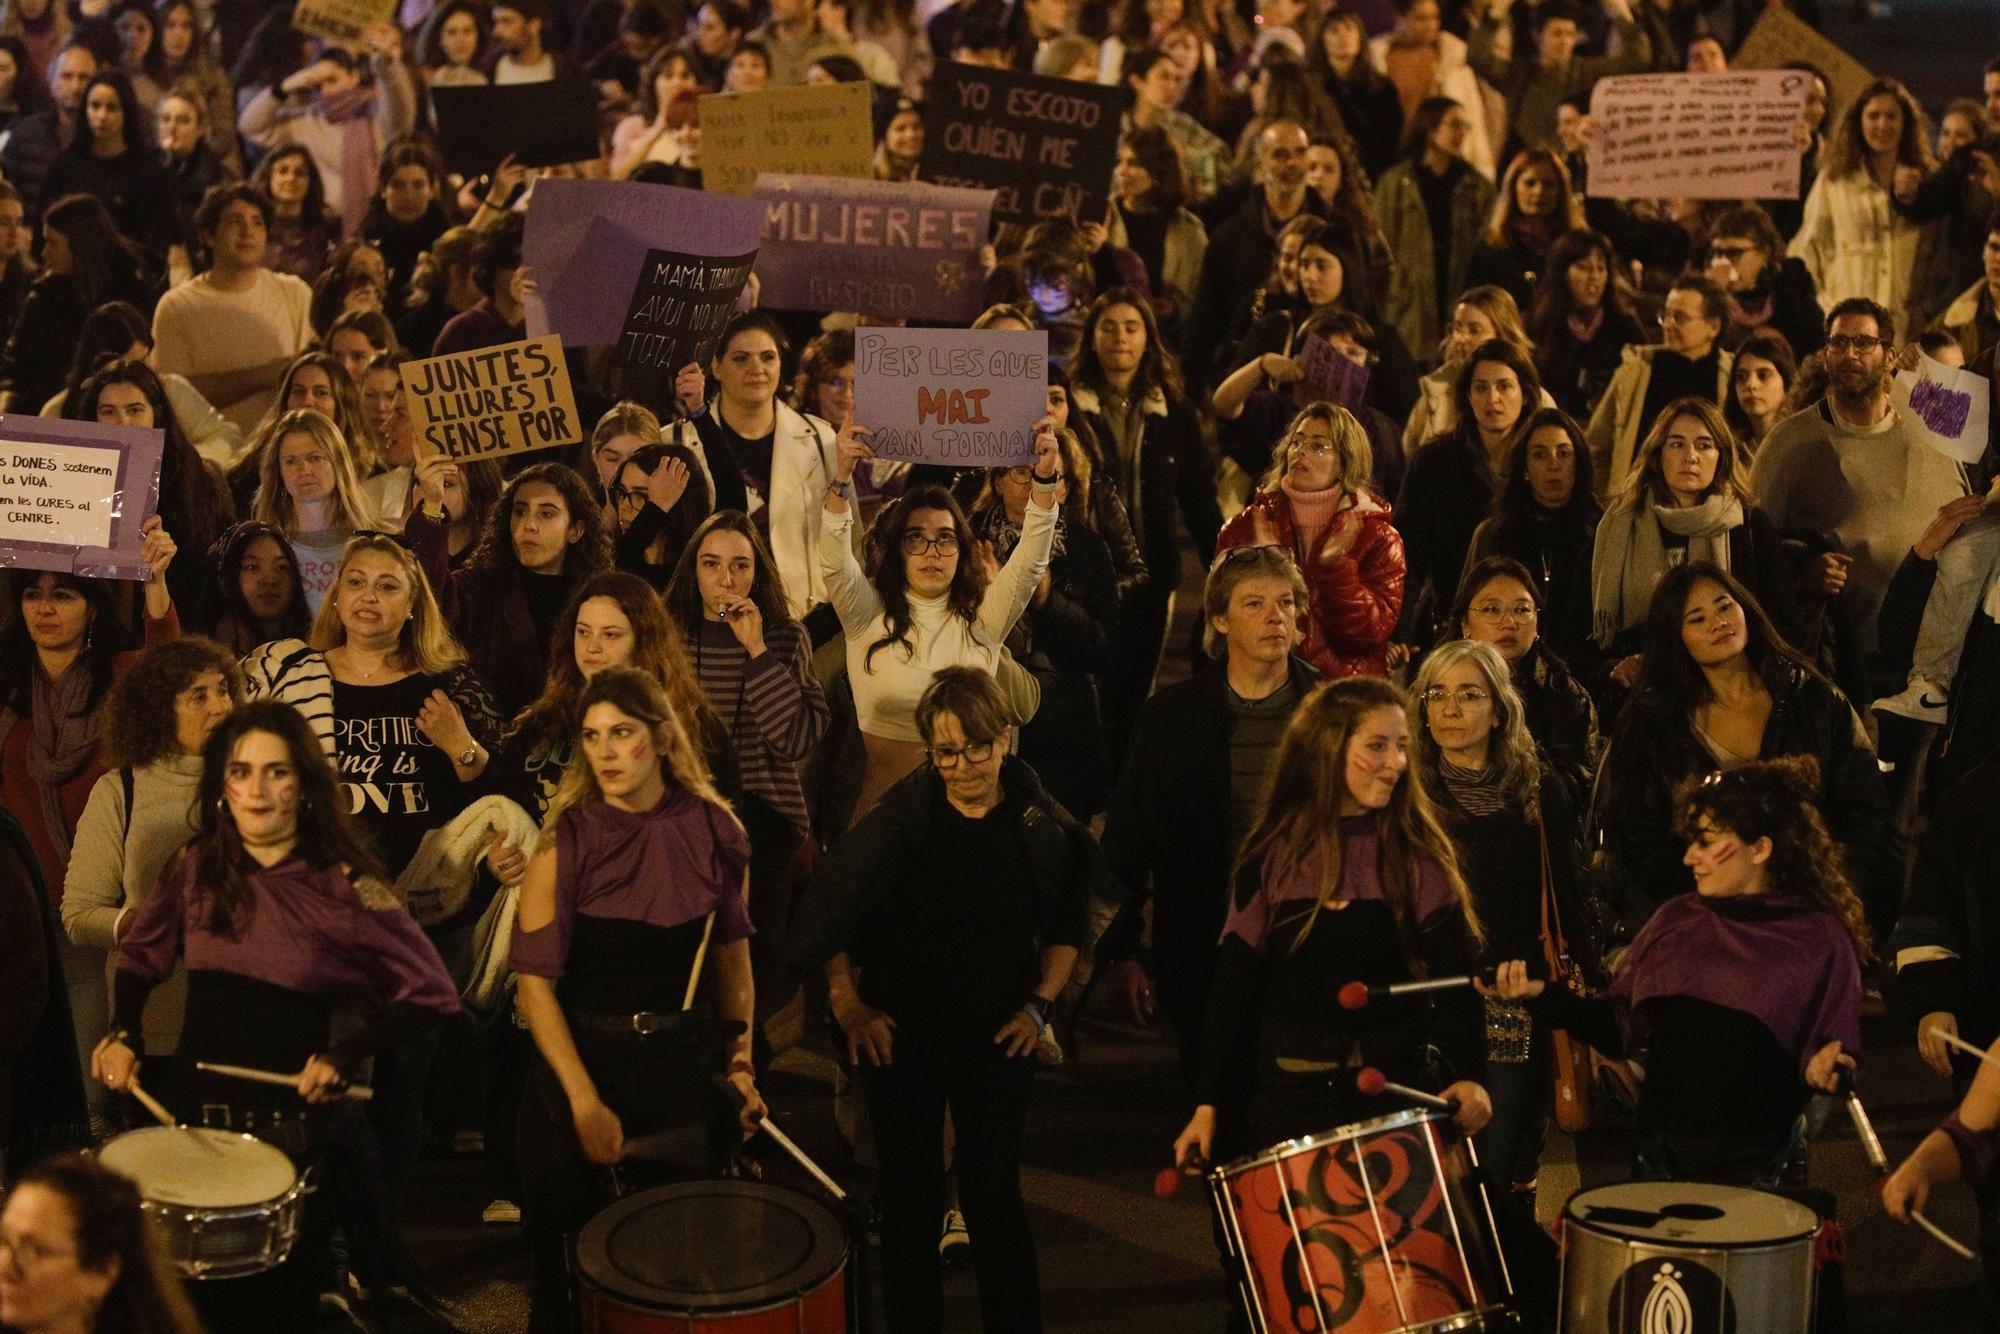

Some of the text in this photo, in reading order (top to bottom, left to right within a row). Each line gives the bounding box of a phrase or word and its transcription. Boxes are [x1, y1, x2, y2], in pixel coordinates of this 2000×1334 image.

[957, 80, 1100, 129] YO ESCOJO
[1039, 136, 1078, 169] ME
[760, 202, 979, 249] MUJERES
[633, 295, 686, 327] AVUI
[688, 303, 711, 331] NO
[411, 343, 558, 396] JUNTES,
[626, 331, 677, 368] TOTA
[860, 334, 1044, 379] PER LES QUE
[423, 378, 556, 423] LLIURES I
[917, 385, 992, 426] MAI
[425, 406, 573, 458] SENSE POR
[12, 455, 57, 471] DONES
[62, 463, 113, 477] sostenem
[18, 496, 32, 506] les
[36, 497, 74, 510] CURES
[78, 501, 90, 511] al
[392, 750, 420, 775] is
